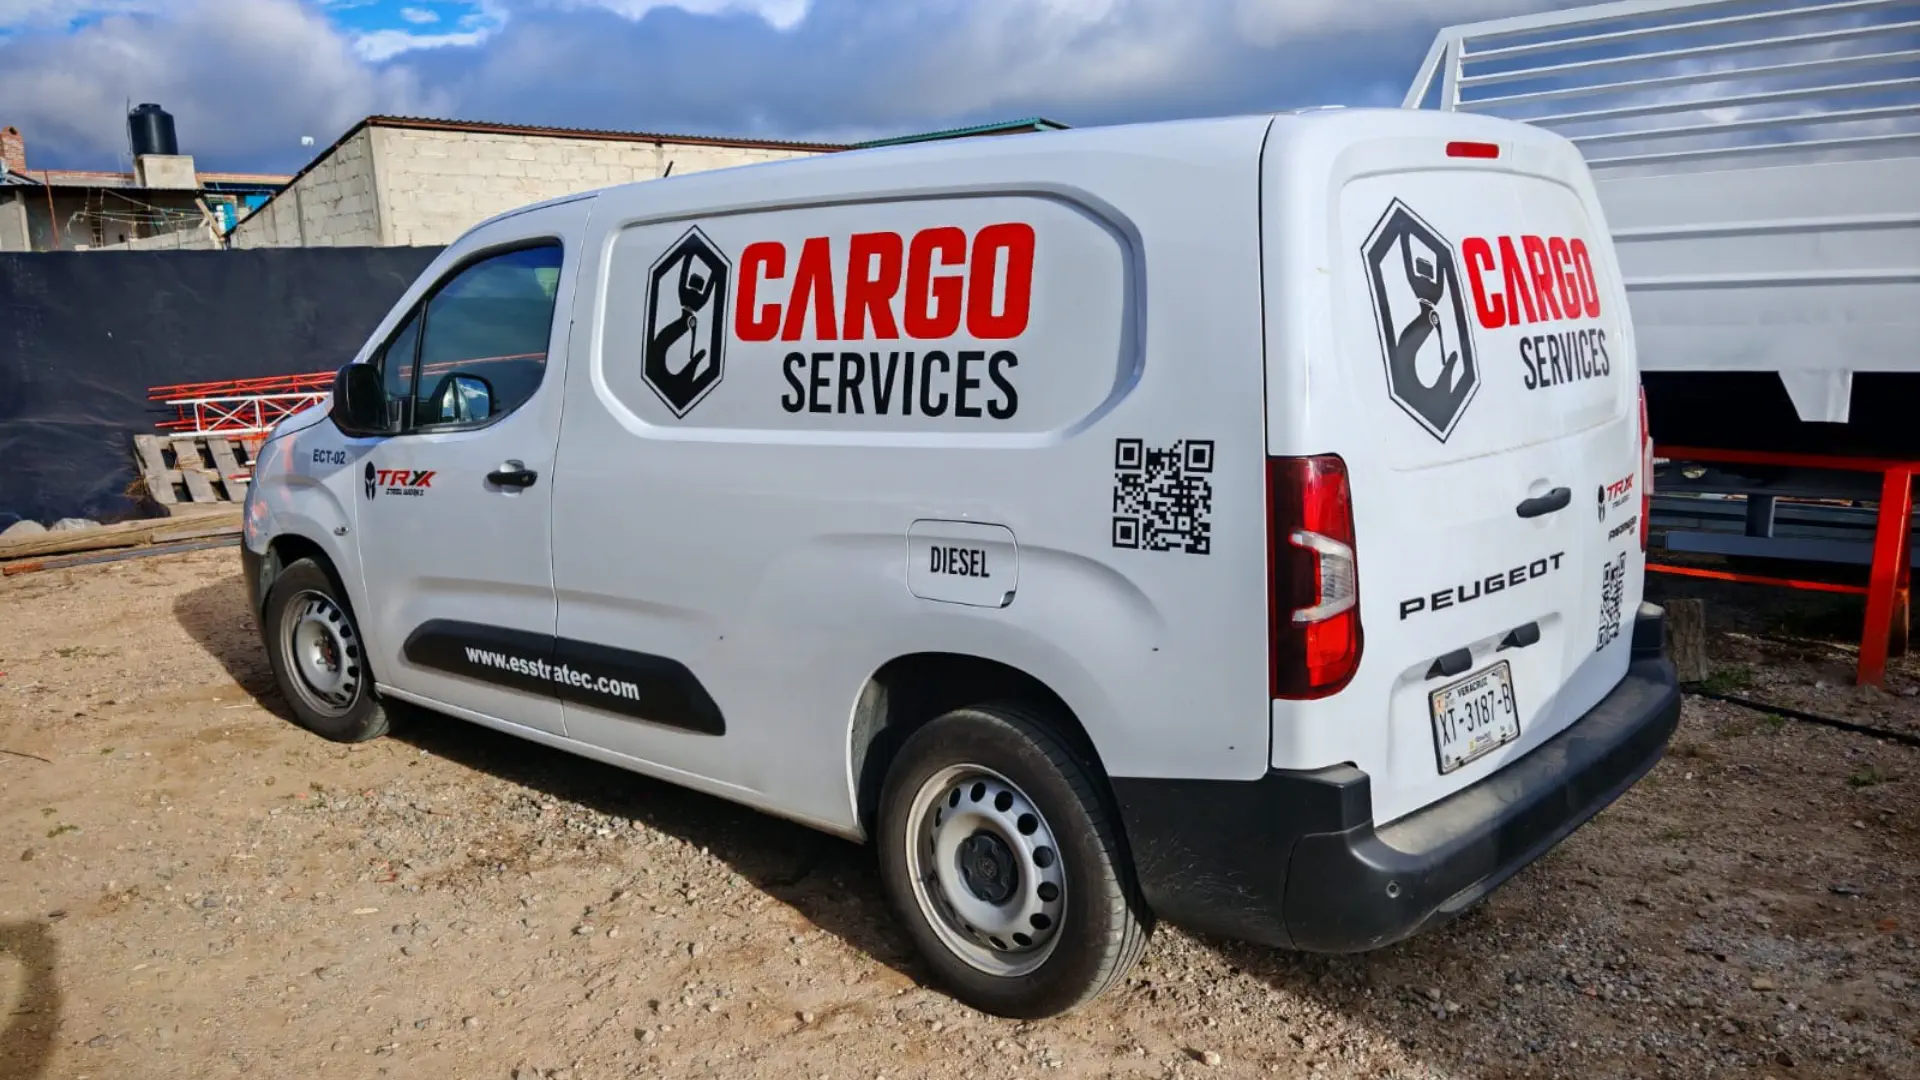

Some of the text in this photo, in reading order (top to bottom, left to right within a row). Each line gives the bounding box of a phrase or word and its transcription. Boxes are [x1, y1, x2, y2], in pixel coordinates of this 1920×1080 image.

[735, 222, 1036, 342] CARGO
[1461, 235, 1601, 329] CARGO
[781, 350, 1018, 420] SERVICES
[1519, 328, 1610, 390] SERVICES
[312, 449, 346, 465] ECT-02
[930, 546, 990, 578] DIESEL
[1399, 551, 1565, 621] PEUGEOT
[465, 646, 640, 701] www.esstratec.com
[1457, 676, 1489, 698] VERACRUZ
